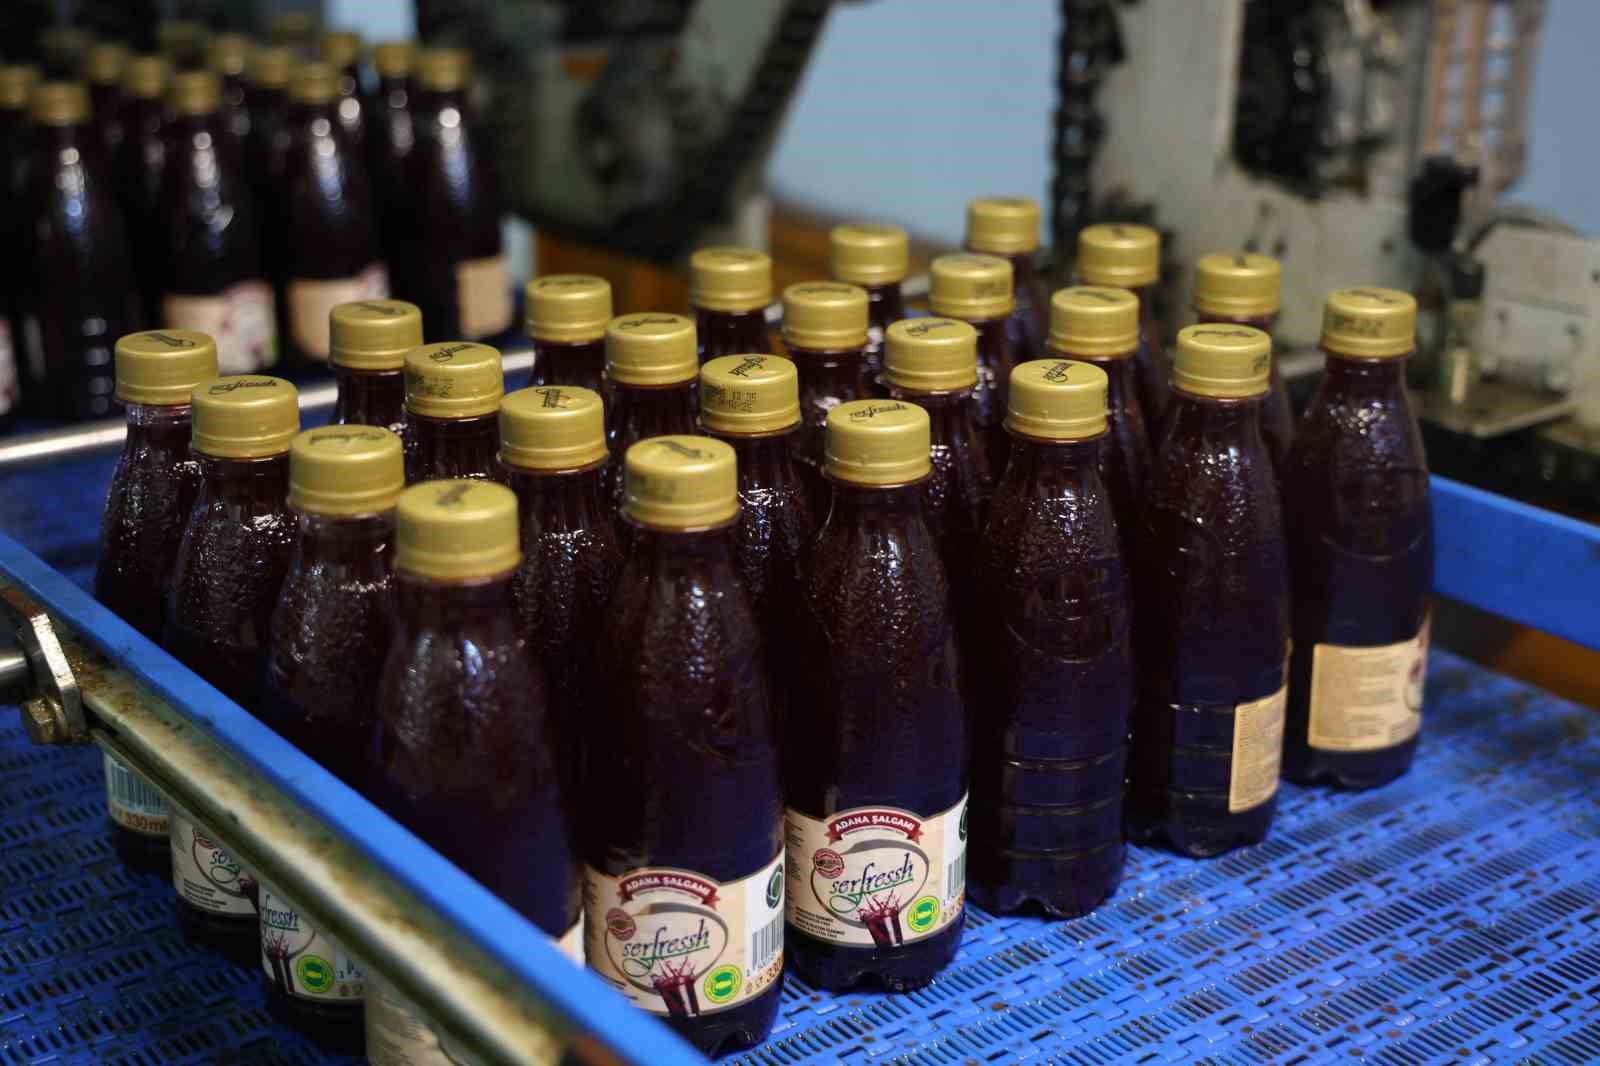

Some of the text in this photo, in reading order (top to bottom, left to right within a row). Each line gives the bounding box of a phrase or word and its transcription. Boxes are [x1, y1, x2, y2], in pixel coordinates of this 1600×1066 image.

[835, 816, 870, 832] ADANA
[872, 815, 915, 831] ŞALGAMI
[626, 876, 660, 892] ADANA
[829, 852, 914, 913] serfressh
[261, 894, 300, 931] fressh
[622, 918, 710, 977] serfressh
